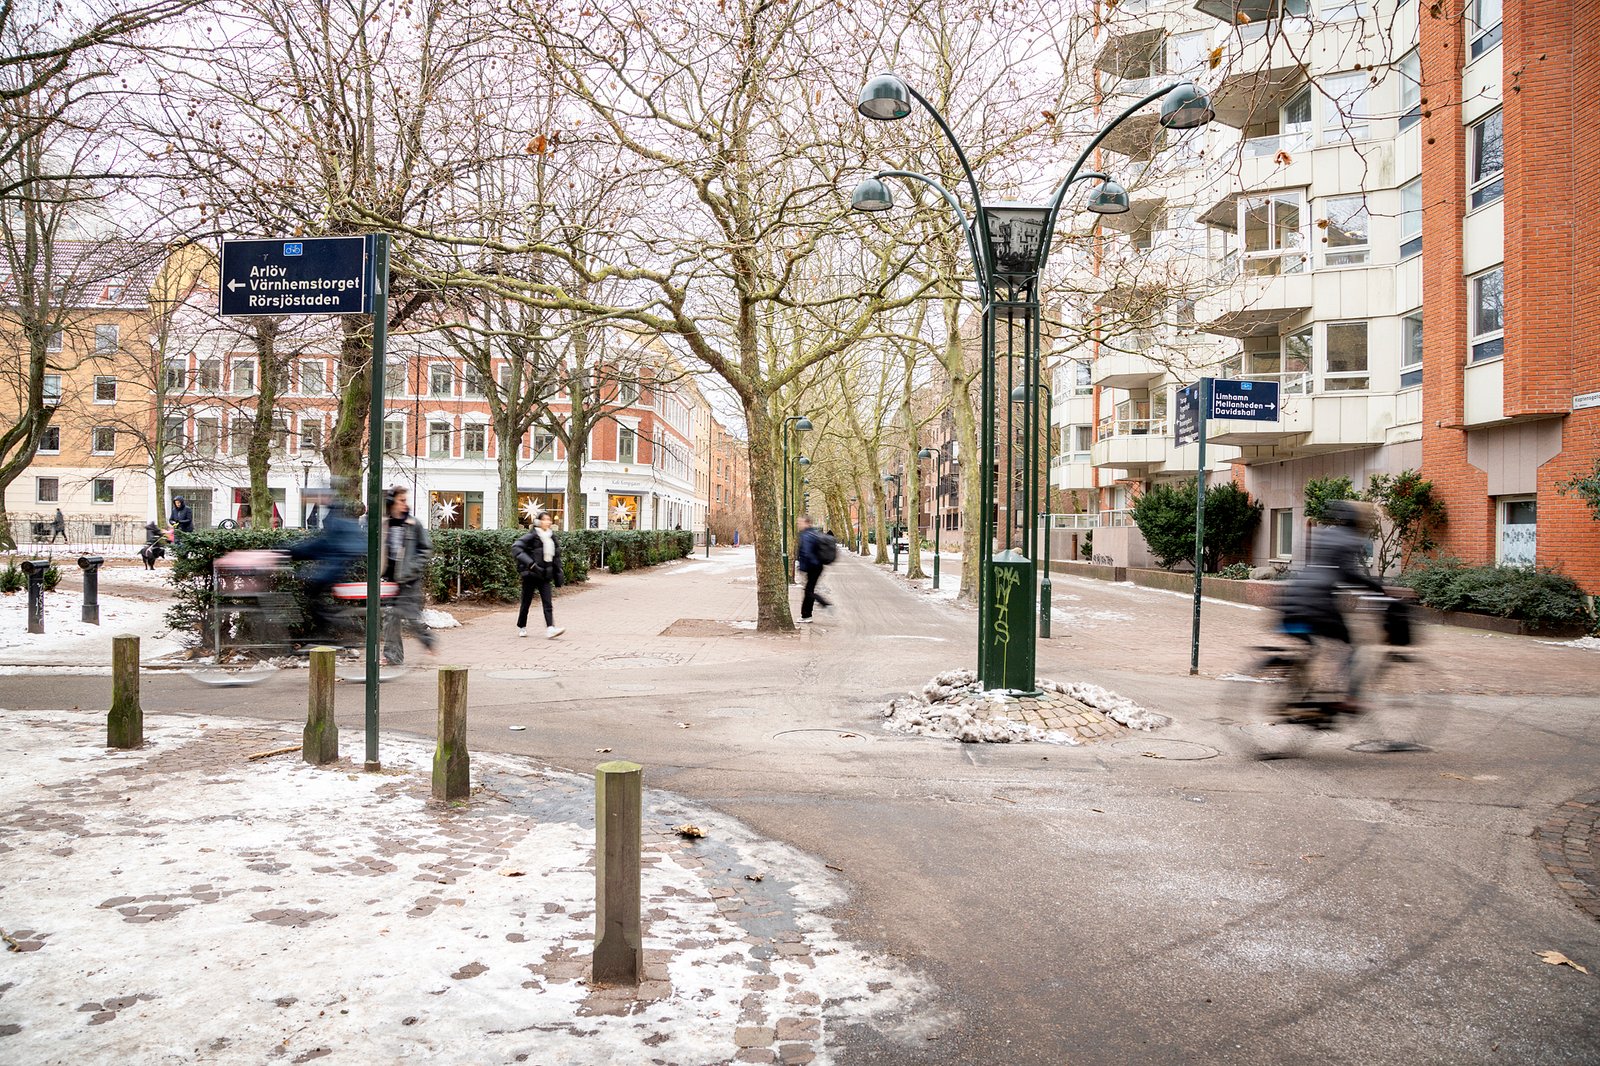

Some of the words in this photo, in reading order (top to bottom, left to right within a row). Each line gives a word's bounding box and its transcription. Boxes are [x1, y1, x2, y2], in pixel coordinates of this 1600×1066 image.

[250, 265, 287, 277] Arlöv
[250, 277, 360, 291] Värnhemstorget
[249, 294, 340, 309] Rörsjöstaden
[1215, 393, 1249, 401] Limhamn
[1215, 400, 1264, 409] Mellanheden
[1215, 408, 1256, 416] Davidshall
